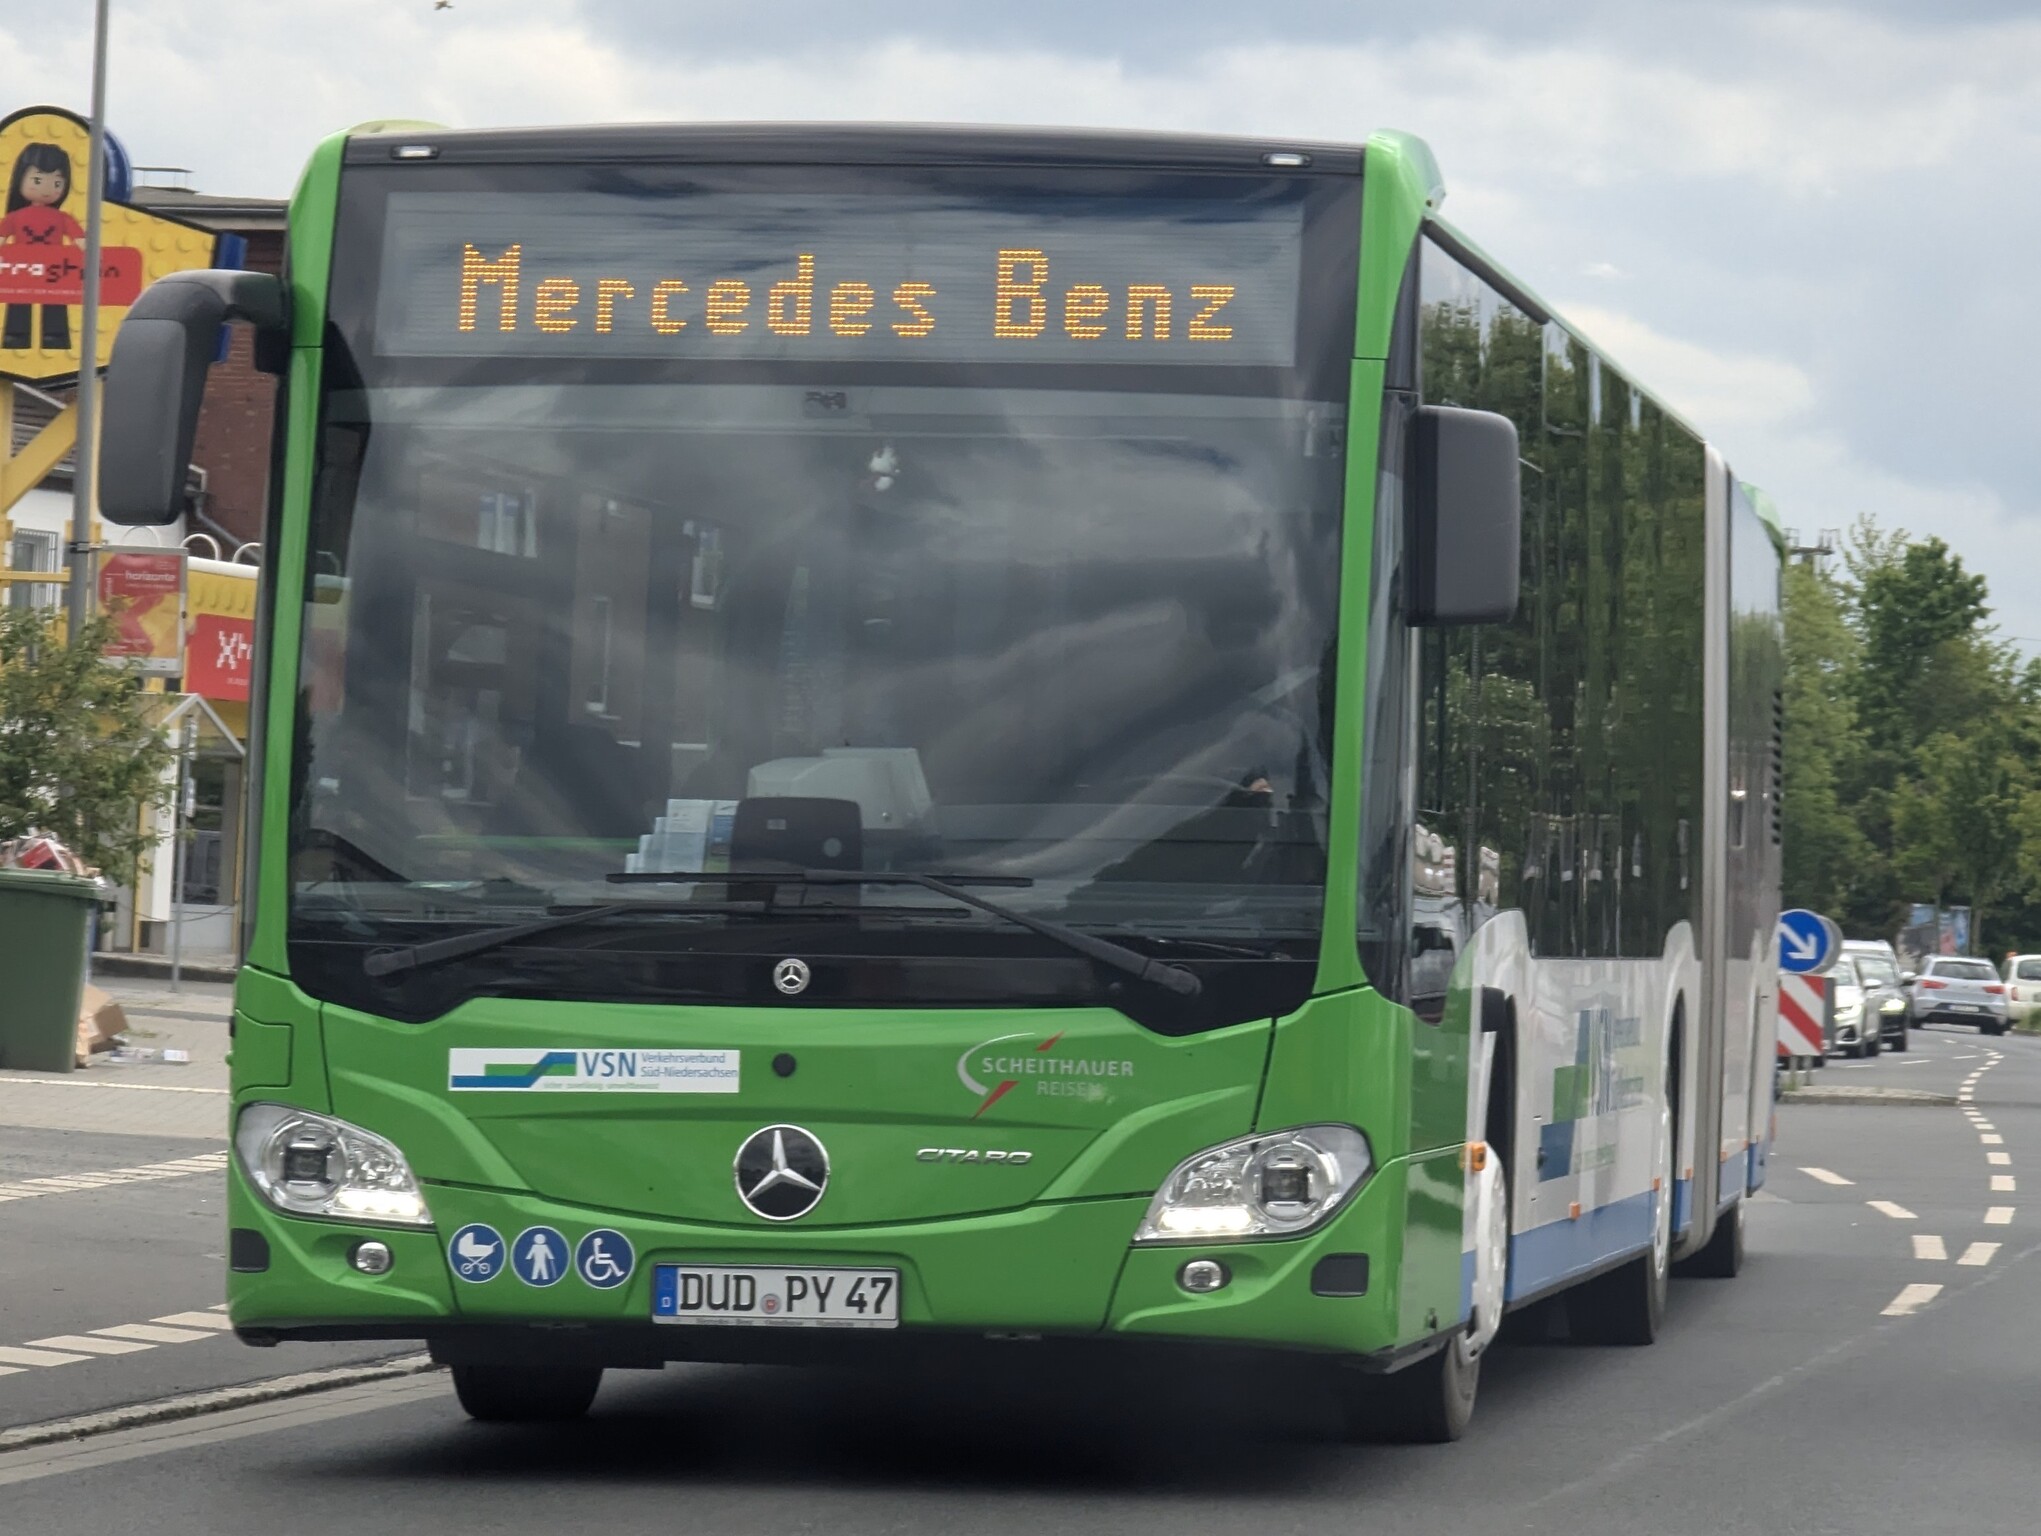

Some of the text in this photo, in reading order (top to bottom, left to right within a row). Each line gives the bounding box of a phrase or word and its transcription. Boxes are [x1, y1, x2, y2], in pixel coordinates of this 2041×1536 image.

[458, 243, 1236, 342] Mercedes Benz
[582, 1051, 637, 1078] VSN
[641, 1052, 726, 1064] Verkehrsverbund
[982, 1057, 1134, 1077] SCHEITHAUER
[640, 1065, 738, 1078] Süd-Niedersachsen
[916, 1148, 1033, 1165] CITARO
[680, 1273, 893, 1314] DUD PY 47
